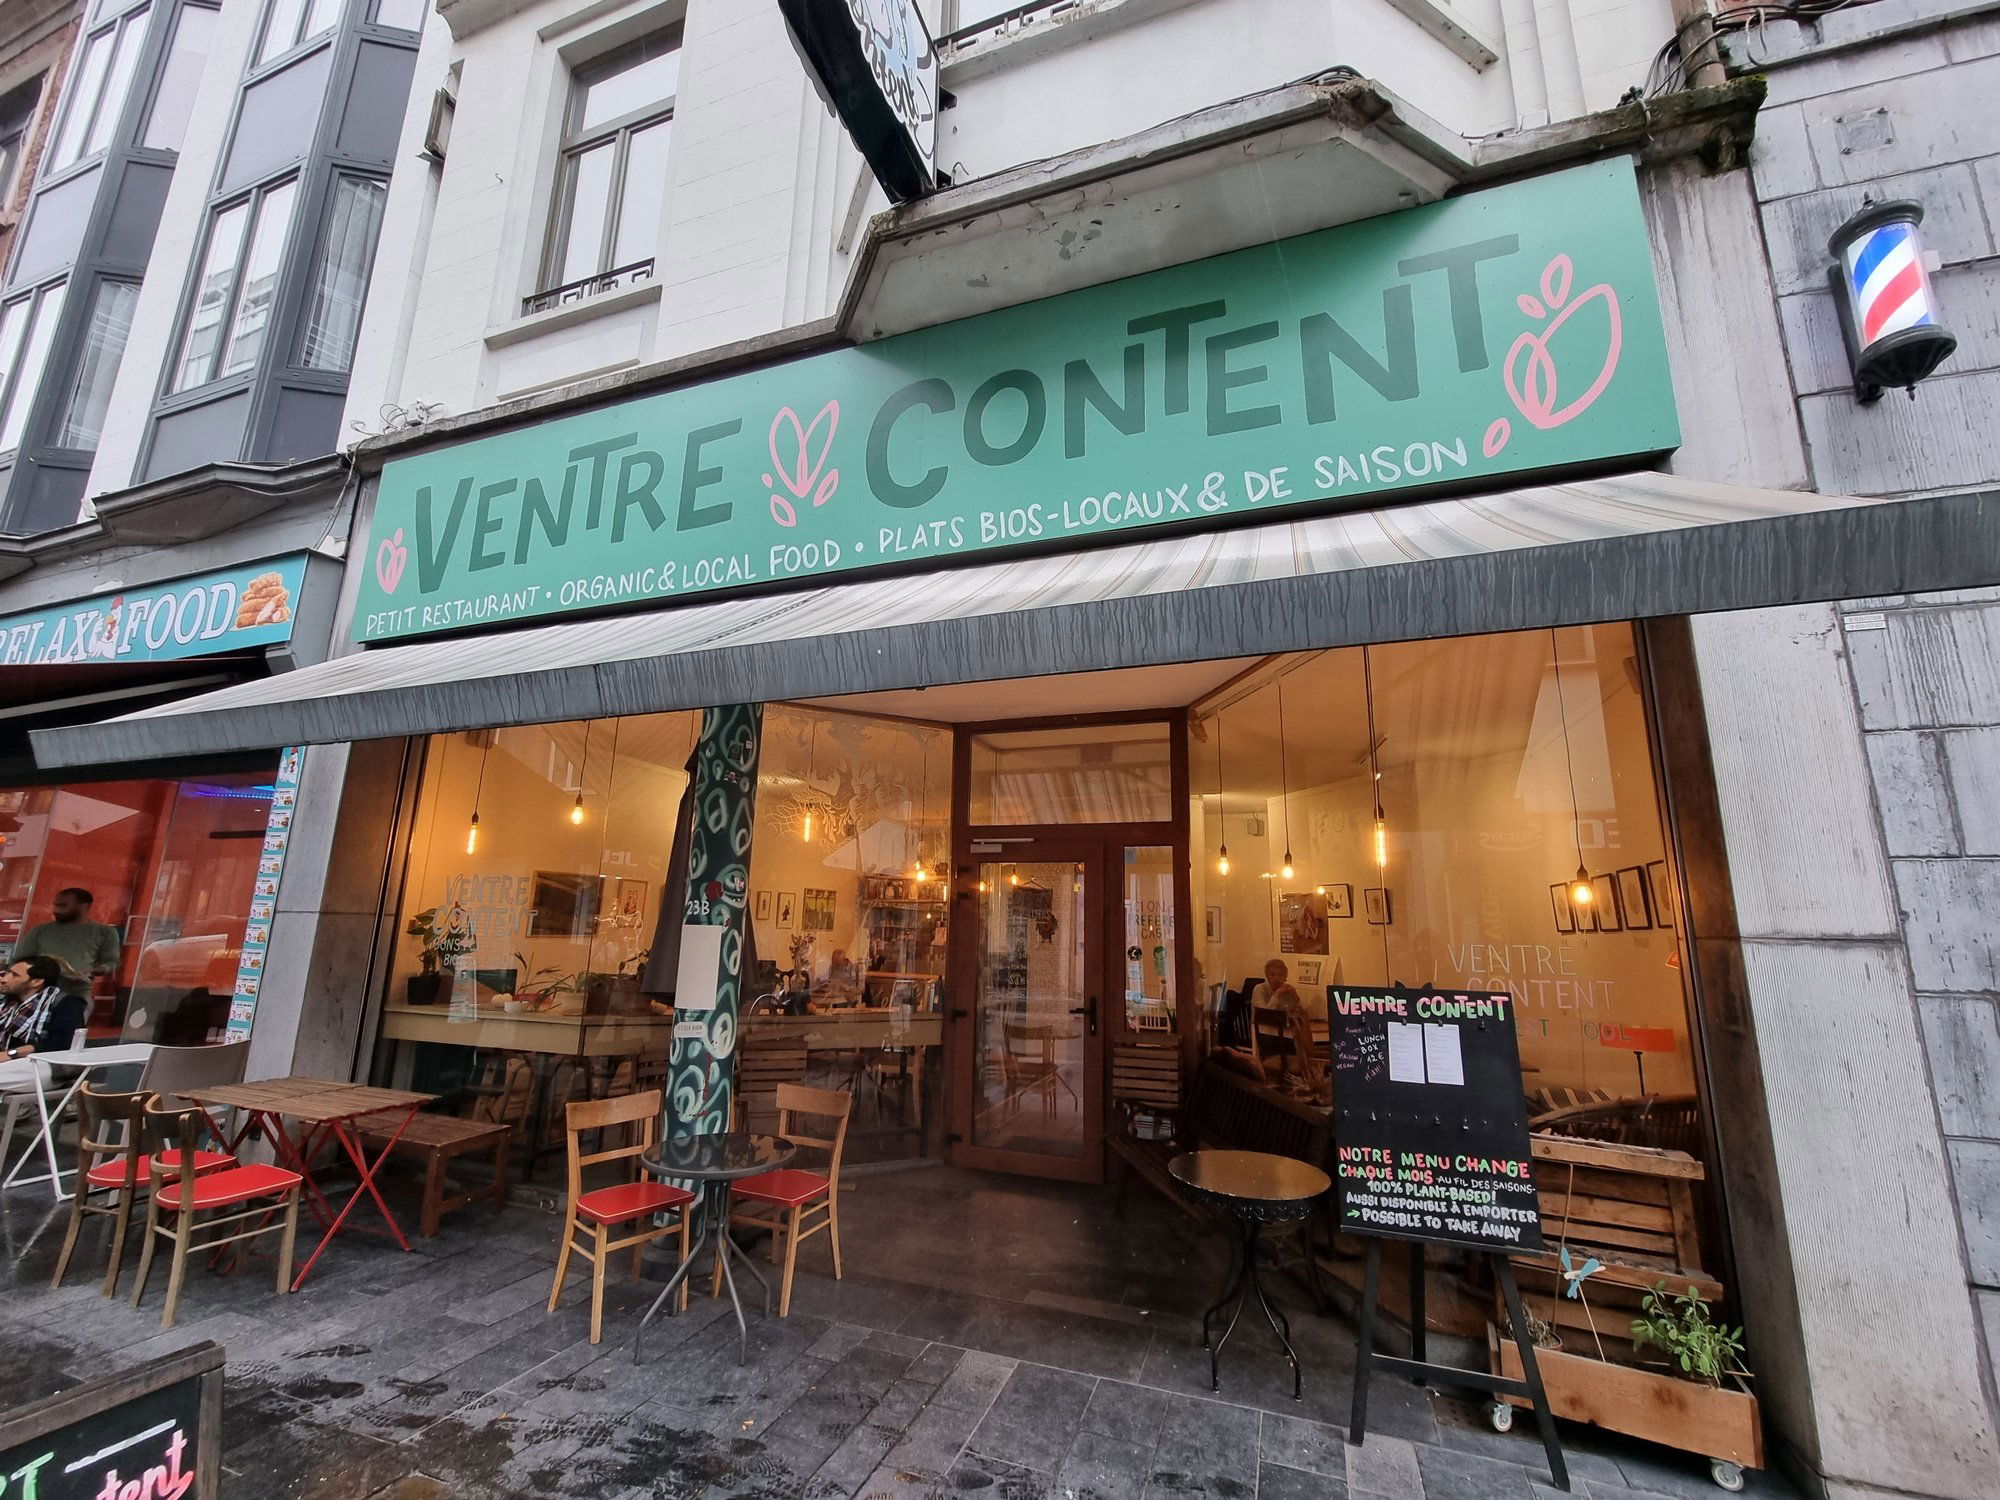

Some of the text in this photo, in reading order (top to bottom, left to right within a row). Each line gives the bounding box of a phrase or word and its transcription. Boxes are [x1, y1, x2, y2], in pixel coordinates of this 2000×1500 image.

[416, 234, 1519, 594] VENTRE CONTENT
[366, 606, 416, 637] PETIT
[423, 586, 541, 628] RESTAURANT
[682, 553, 757, 589] LOCAL
[769, 539, 841, 576] FOOD
[879, 516, 965, 553] PLATS
[1196, 471, 1228, 512] &
[1243, 466, 1293, 503] DE
[1314, 437, 1468, 489] SAISON
[117, 581, 237, 654] FOOD
[446, 873, 531, 906] VENTRE
[687, 900, 711, 916] 23B
[1448, 943, 1577, 977] VENTRE
[1333, 991, 1510, 1022] VENTRE CONTENT
[1358, 1034, 1386, 1046] LUNCH
[1360, 1043, 1379, 1055] BOX
[1338, 1163, 1394, 1182] CHAQUE
[1398, 1169, 1434, 1185] MOIS
[1454, 1177, 1469, 1188] FIL
[1471, 1178, 1490, 1190] DES
[1339, 1147, 1530, 1180] NOTRE MENU CHANGE
[1367, 1180, 1403, 1195] 100%
[1346, 1191, 1379, 1207] AUSSI
[1381, 1196, 1448, 1214] DISPONIBLE
[1463, 1205, 1538, 1224] EMPORTER
[1361, 1208, 1521, 1242] POSSIBLE TO TAKE AWAY
